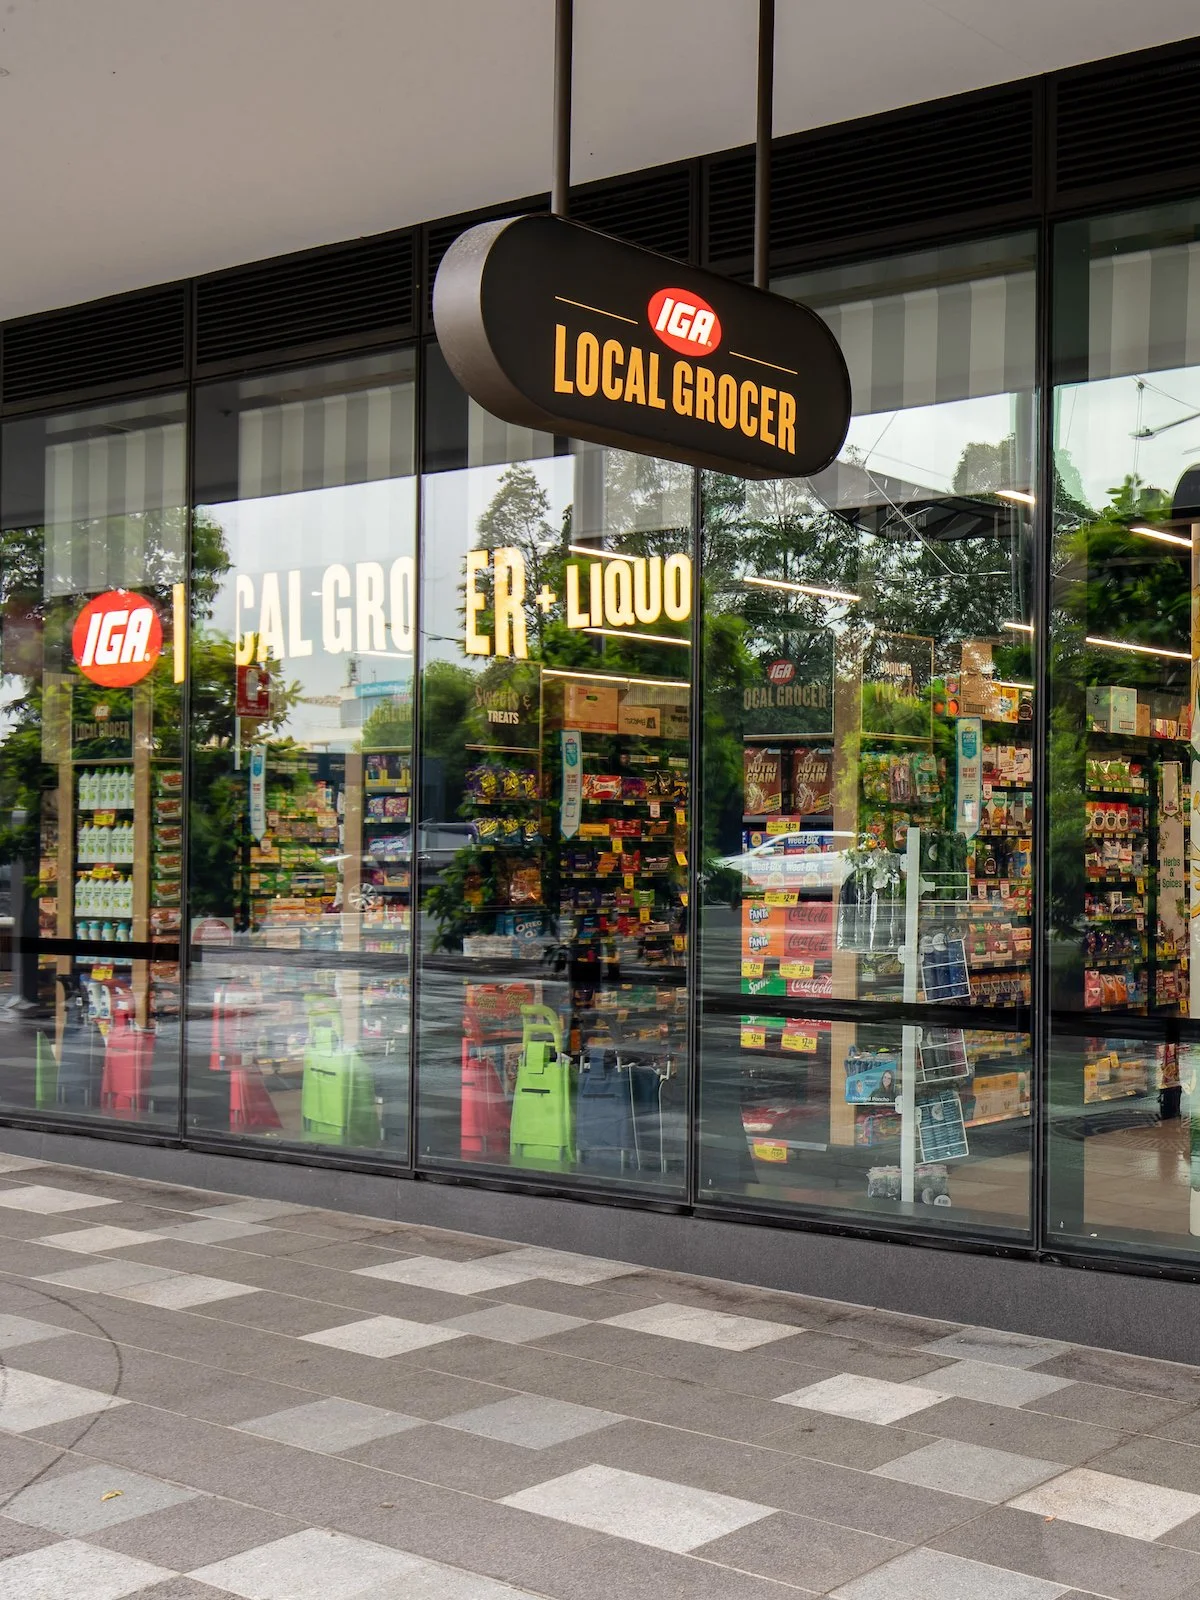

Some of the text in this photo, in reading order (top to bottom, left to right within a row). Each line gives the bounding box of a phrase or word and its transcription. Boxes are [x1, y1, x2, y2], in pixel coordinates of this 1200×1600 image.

[655, 297, 715, 346] IGA
[554, 323, 797, 455] LOCAL GROCER
[81, 606, 151, 667] IGA
[566, 553, 692, 629] LIQUO
[769, 663, 793, 679] IGA
[743, 684, 827, 710] OCAL GROCER
[487, 710, 519, 725] TREATS
[747, 762, 778, 773] NUTRI
[797, 762, 828, 773] NUTRI
[746, 772, 776, 783] GRAIN
[796, 772, 827, 783] GRAIN
[1163, 857, 1181, 867] Herbs
[1169, 867, 1175, 877] &
[1162, 878, 1182, 890] Spices
[748, 908, 769, 920] FANTA
[516, 921, 542, 932] OREO
[748, 936, 769, 948] FANTA
